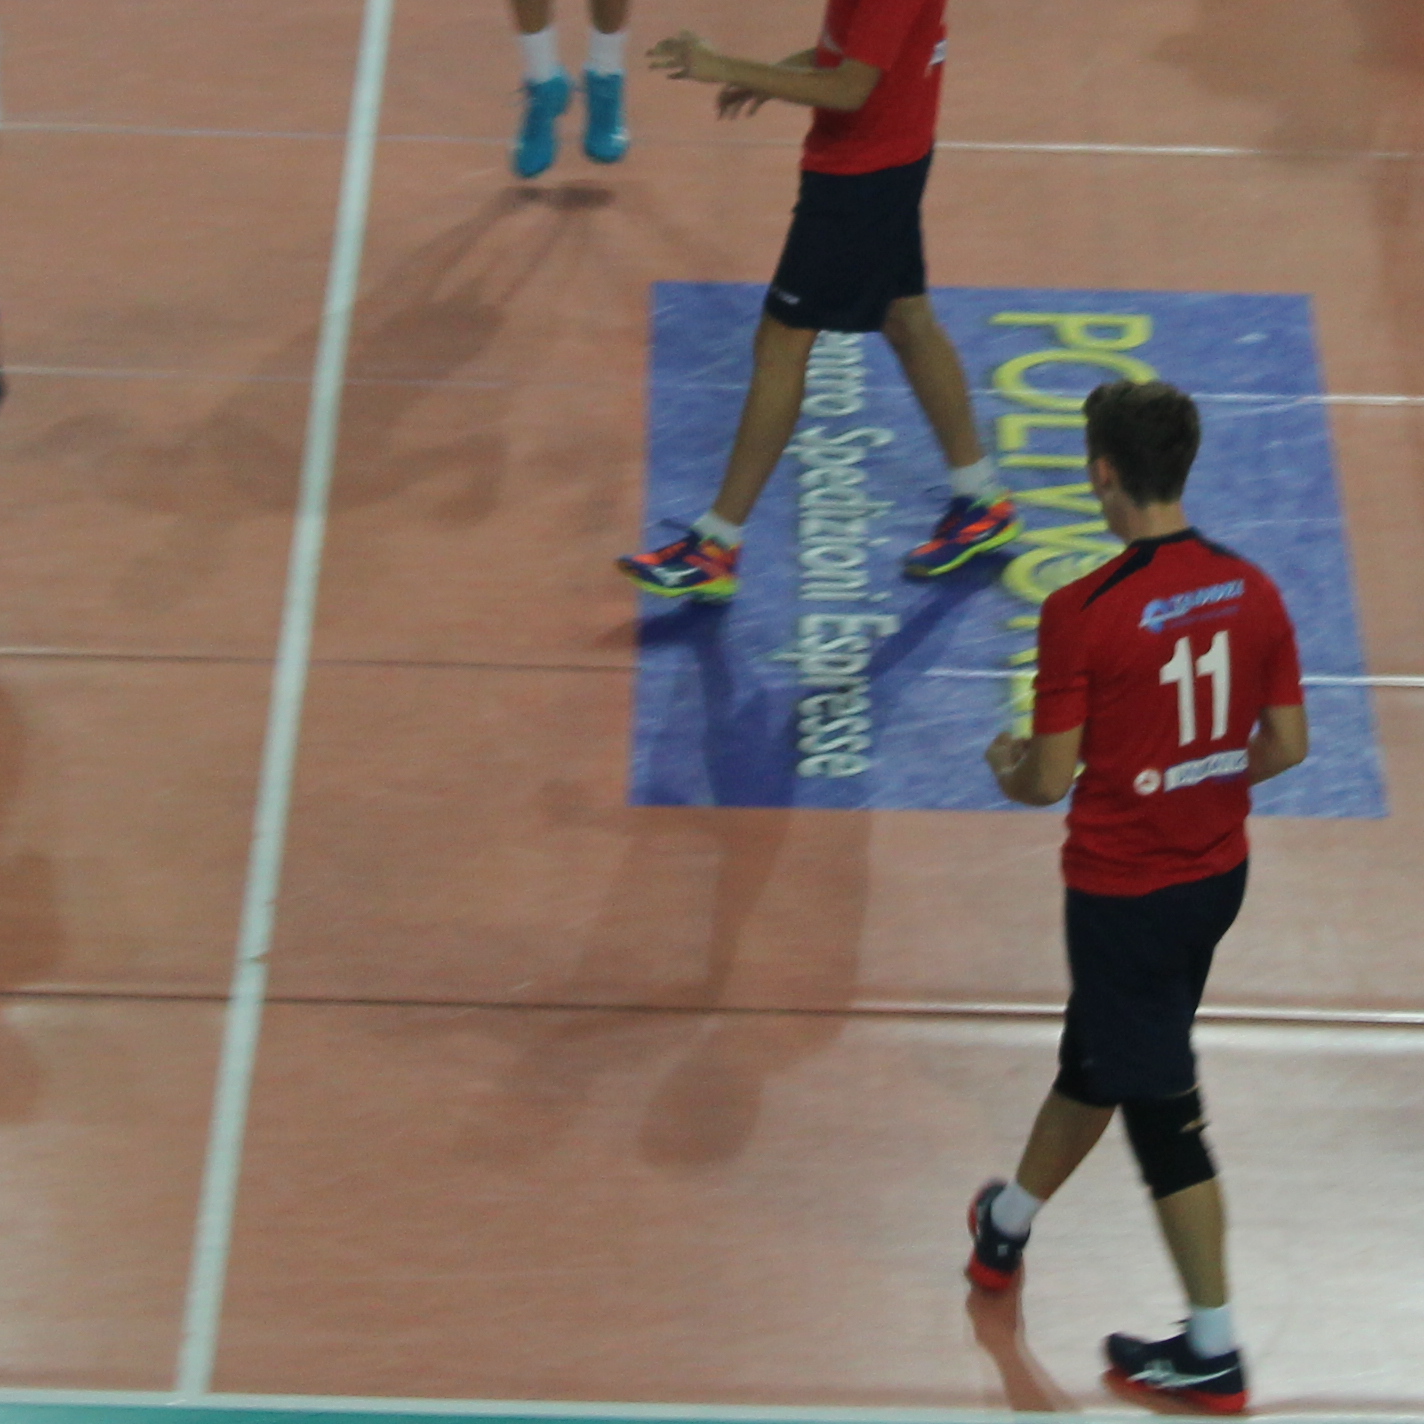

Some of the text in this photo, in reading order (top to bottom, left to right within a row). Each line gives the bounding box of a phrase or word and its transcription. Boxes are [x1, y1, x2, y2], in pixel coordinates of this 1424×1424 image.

[784, 424, 896, 602] Spedizioni
[770, 612, 901, 779] Espresse
[1158, 629, 1233, 748] 11
